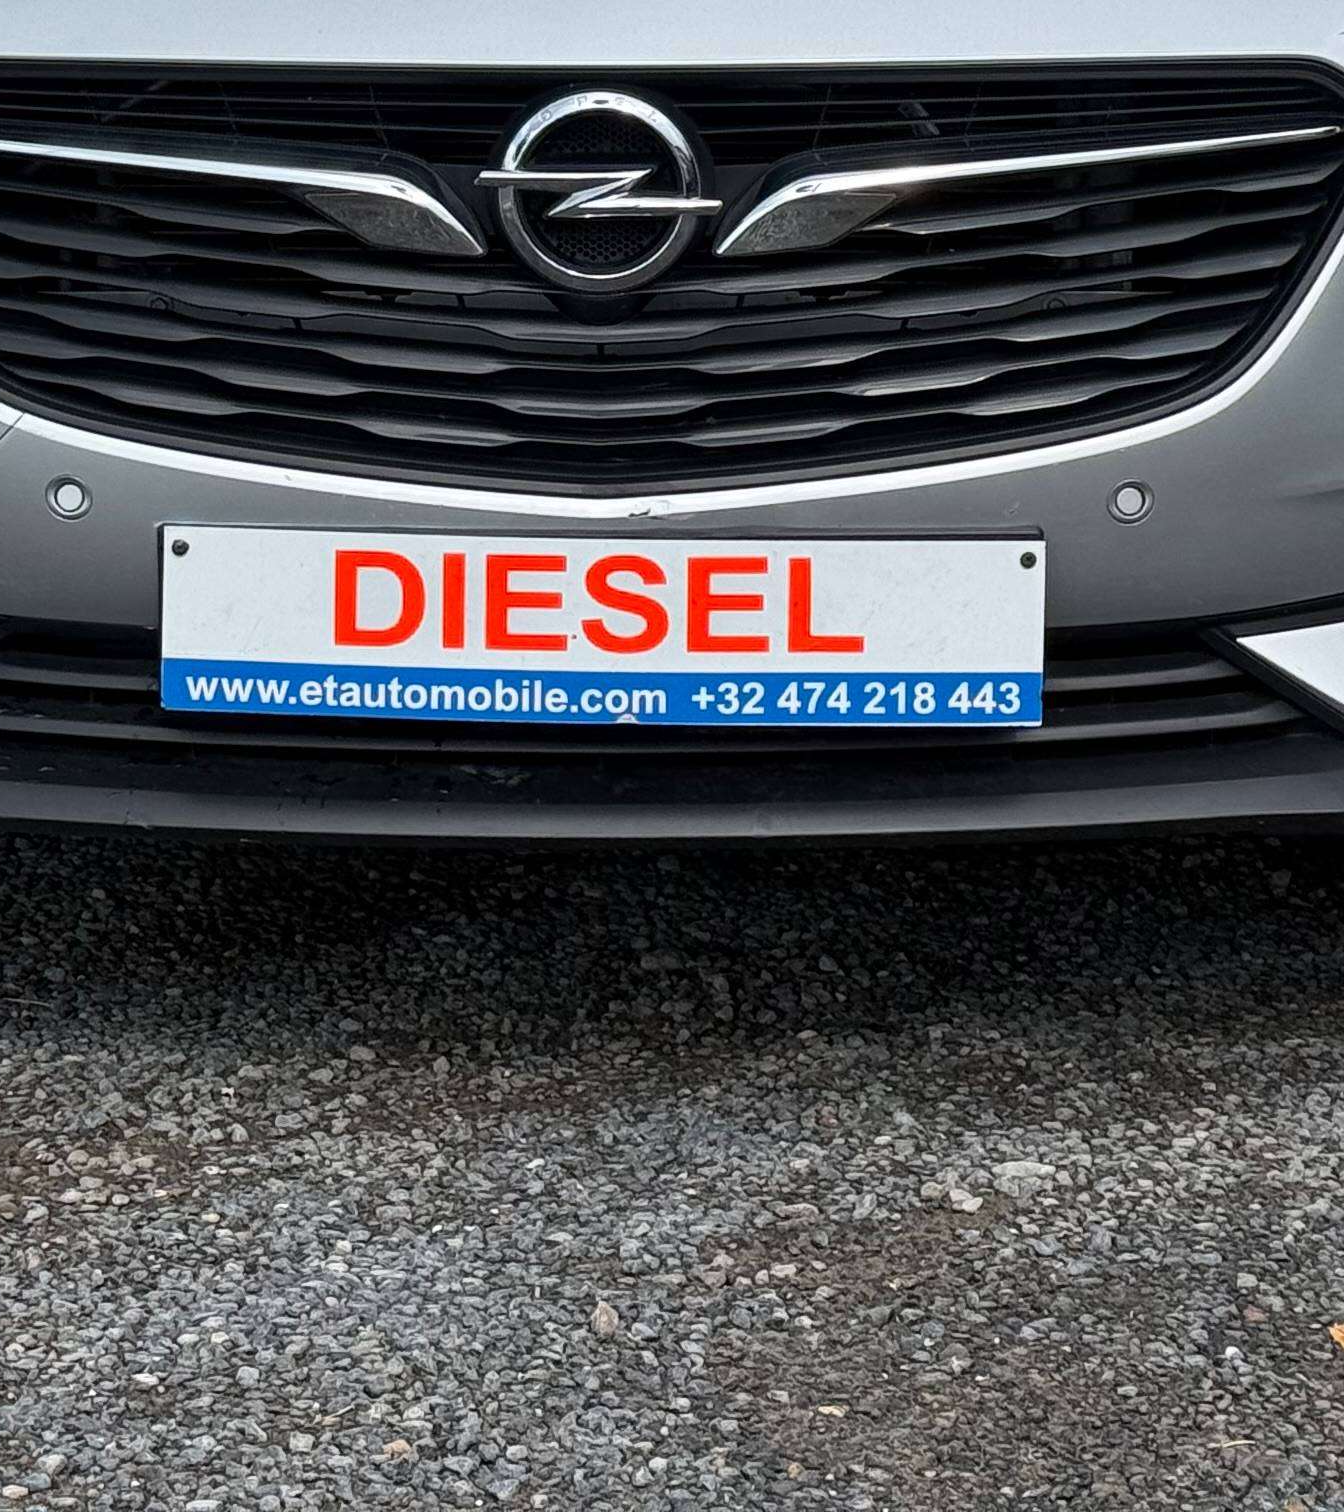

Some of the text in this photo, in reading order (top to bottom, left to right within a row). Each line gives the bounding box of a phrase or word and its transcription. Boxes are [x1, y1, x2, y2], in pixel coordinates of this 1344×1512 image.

[333, 548, 865, 654] DIESEL
[185, 674, 1021, 715] www.etautomobile.com +32 474 218 443
